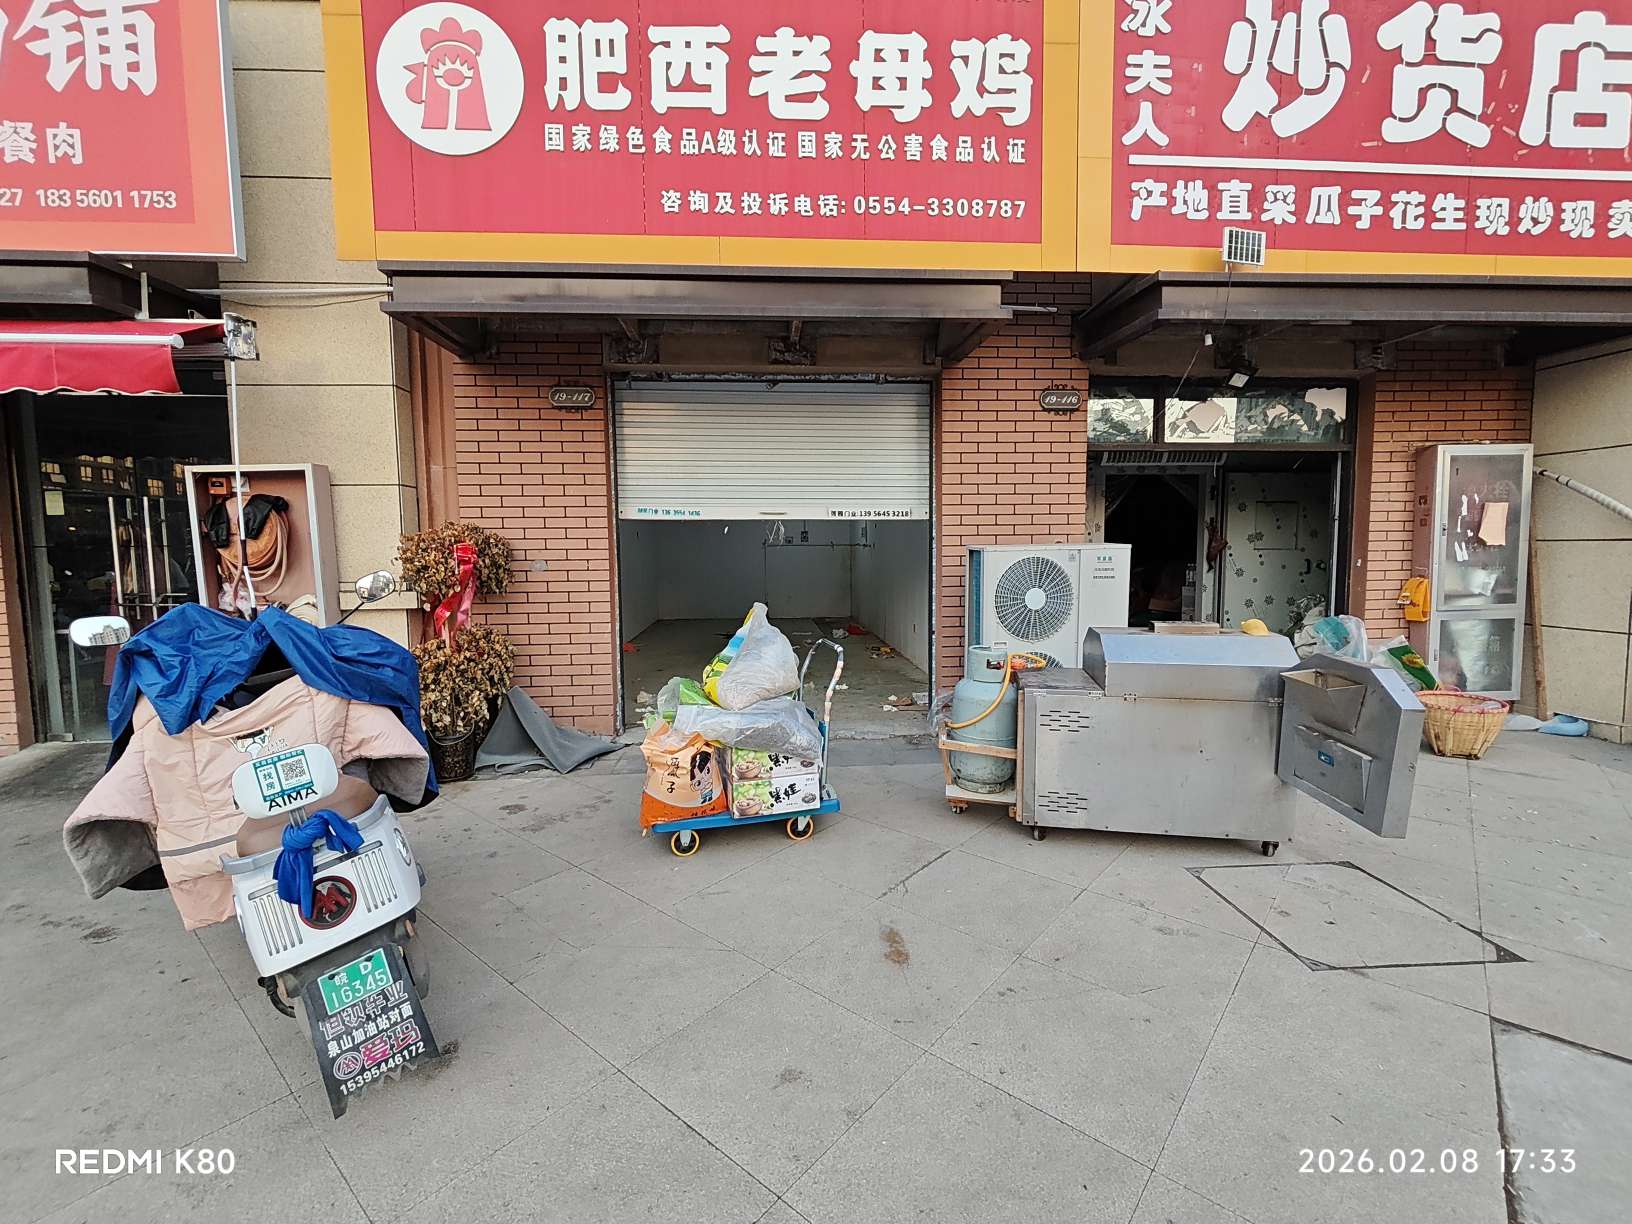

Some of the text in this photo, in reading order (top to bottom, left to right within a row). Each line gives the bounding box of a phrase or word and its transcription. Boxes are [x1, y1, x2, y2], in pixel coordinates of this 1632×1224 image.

[542, 16, 1033, 127] 肥西老母鸡
[1221, 0, 1632, 149] 炒货店
[797, 130, 1027, 164] 国家无公害食品认证
[36, 189, 72, 208] 183
[76, 190, 122, 208] 5601
[130, 190, 177, 209] 1753
[1130, 178, 1632, 240] 产地直采瓜子花生现炒现卖
[859, 510, 872, 518] 139
[873, 510, 891, 518] 5645
[268, 787, 319, 812] AIMA
[334, 961, 372, 986] 皖 D
[326, 1001, 414, 1059] 泉山加油站对面
[339, 1041, 426, 1096] 15395446172
